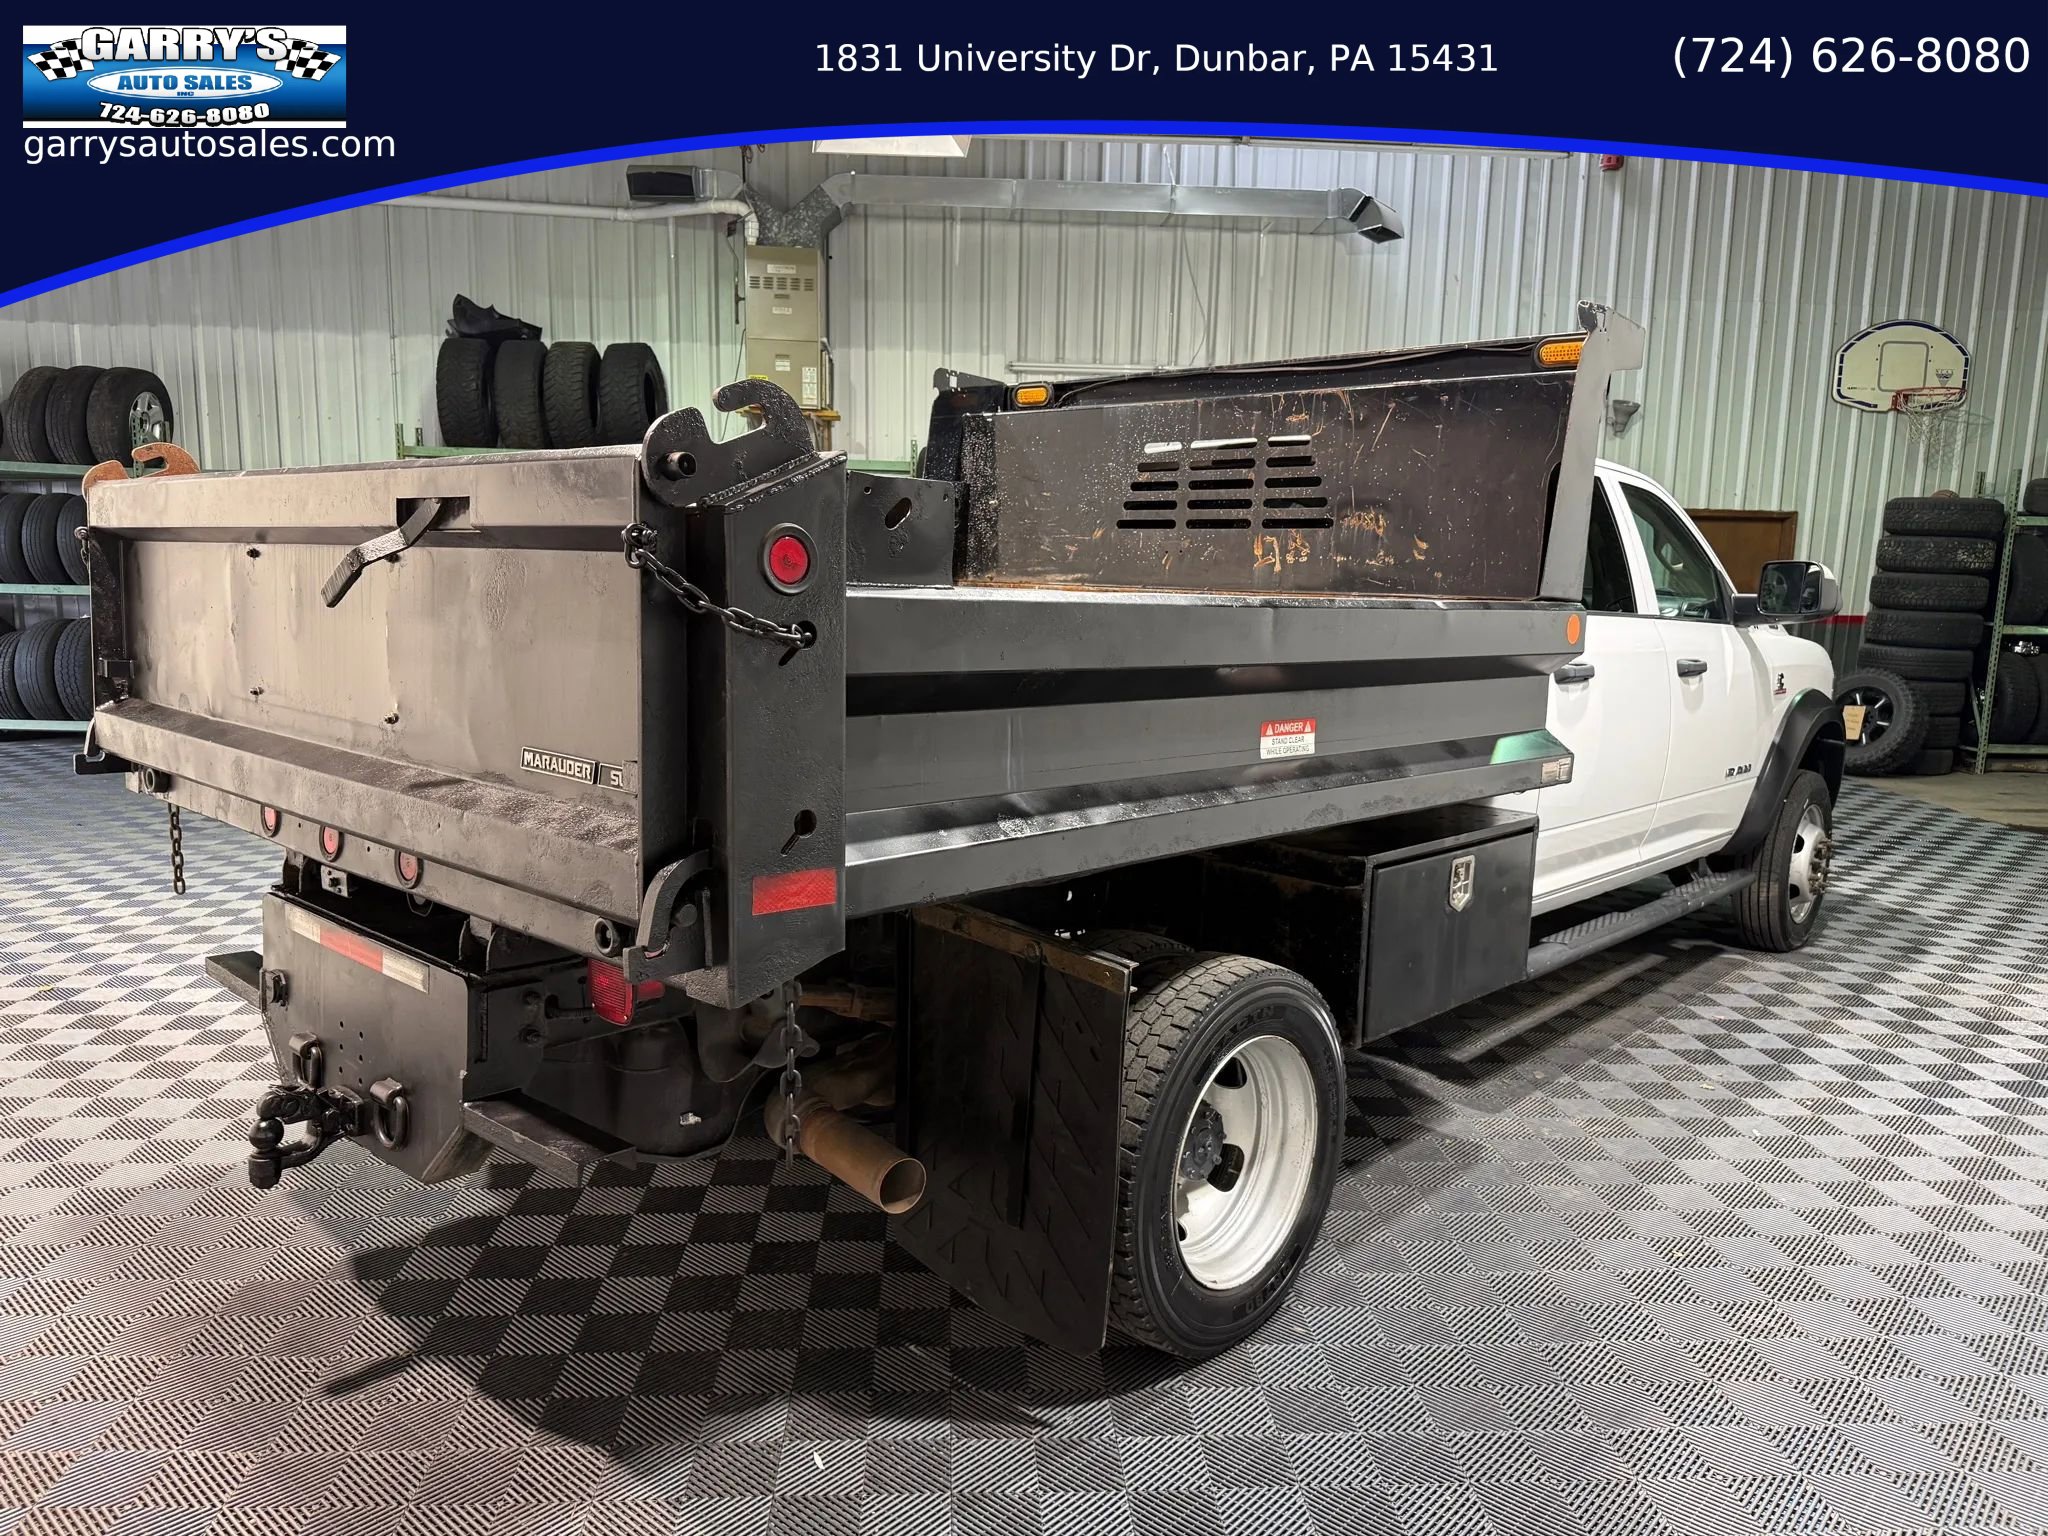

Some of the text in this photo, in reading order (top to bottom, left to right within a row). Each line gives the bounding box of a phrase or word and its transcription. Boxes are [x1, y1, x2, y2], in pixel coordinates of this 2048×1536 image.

[1274, 722, 1304, 734] DANGER
[1271, 735, 1305, 746] STAND CLEAR
[1266, 745, 1310, 756] WHILE OPERATING
[523, 751, 591, 780] MARAUDER
